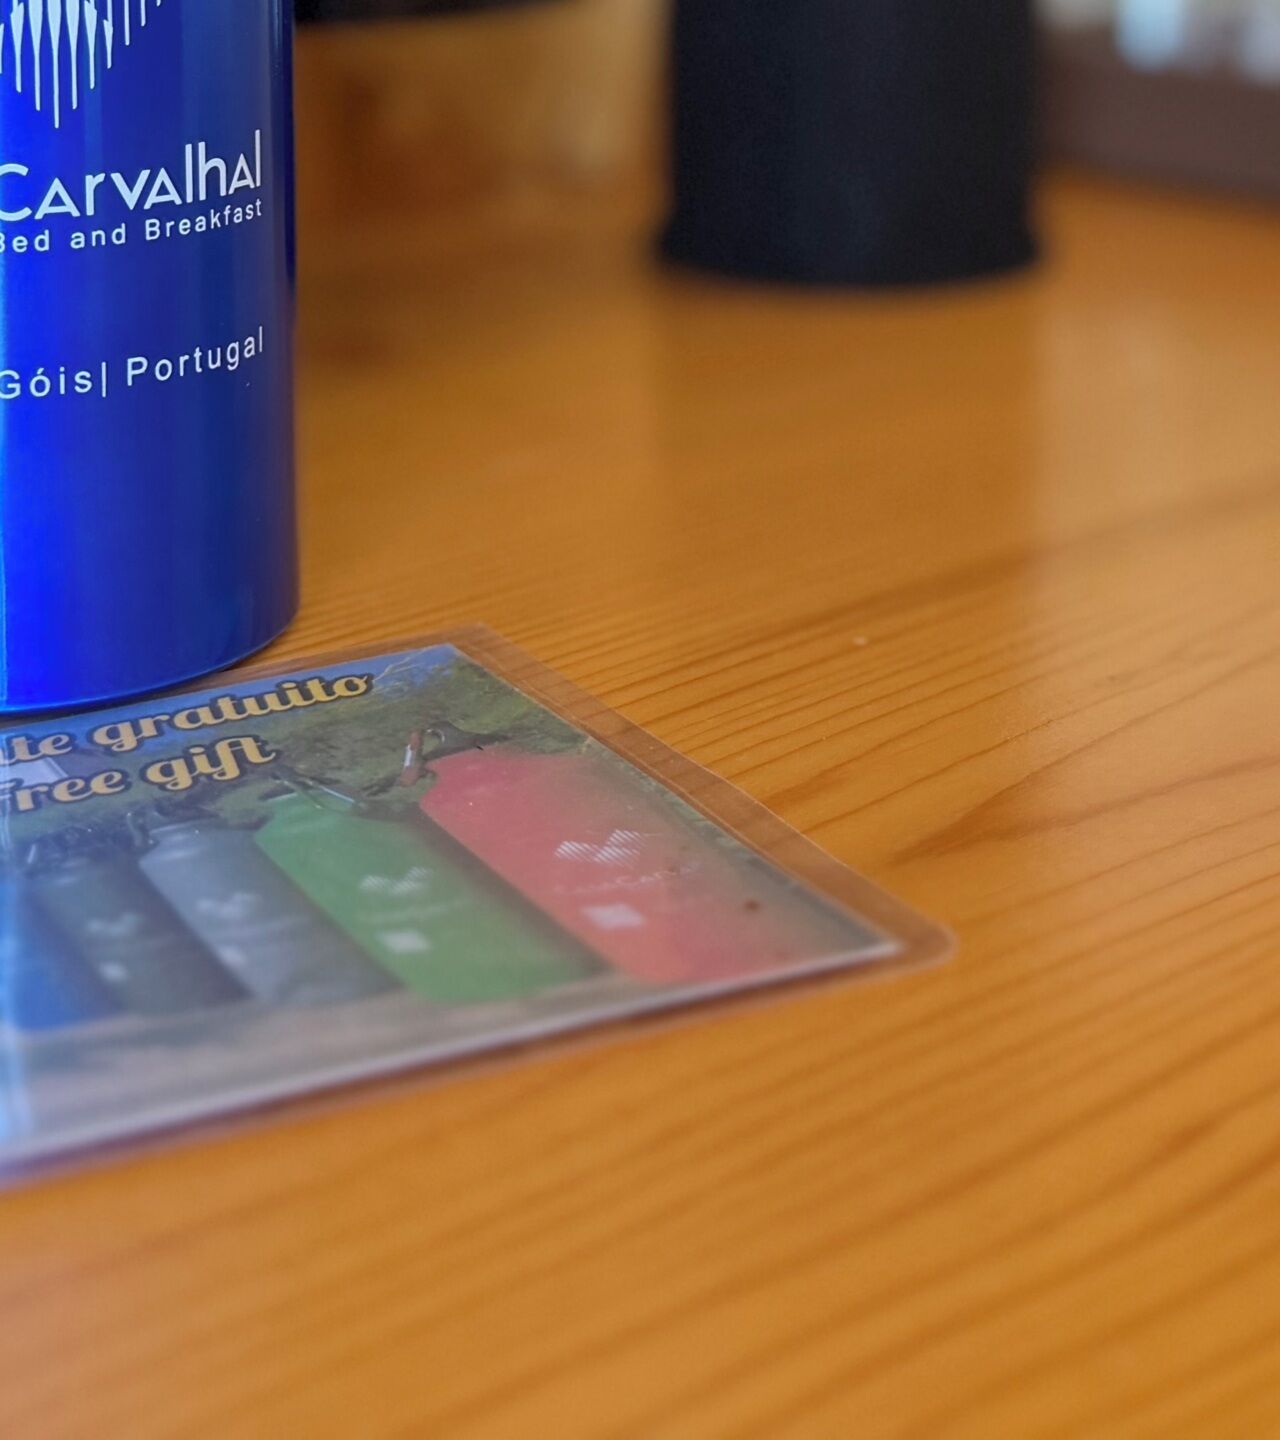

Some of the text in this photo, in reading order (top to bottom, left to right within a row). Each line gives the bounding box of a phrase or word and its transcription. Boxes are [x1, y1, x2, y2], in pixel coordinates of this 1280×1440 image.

[70, 222, 127, 249] and
[144, 198, 263, 241] Breakfast
[126, 326, 263, 387] Portugal
[91, 671, 376, 756] gratuito
[142, 733, 283, 793] gift
